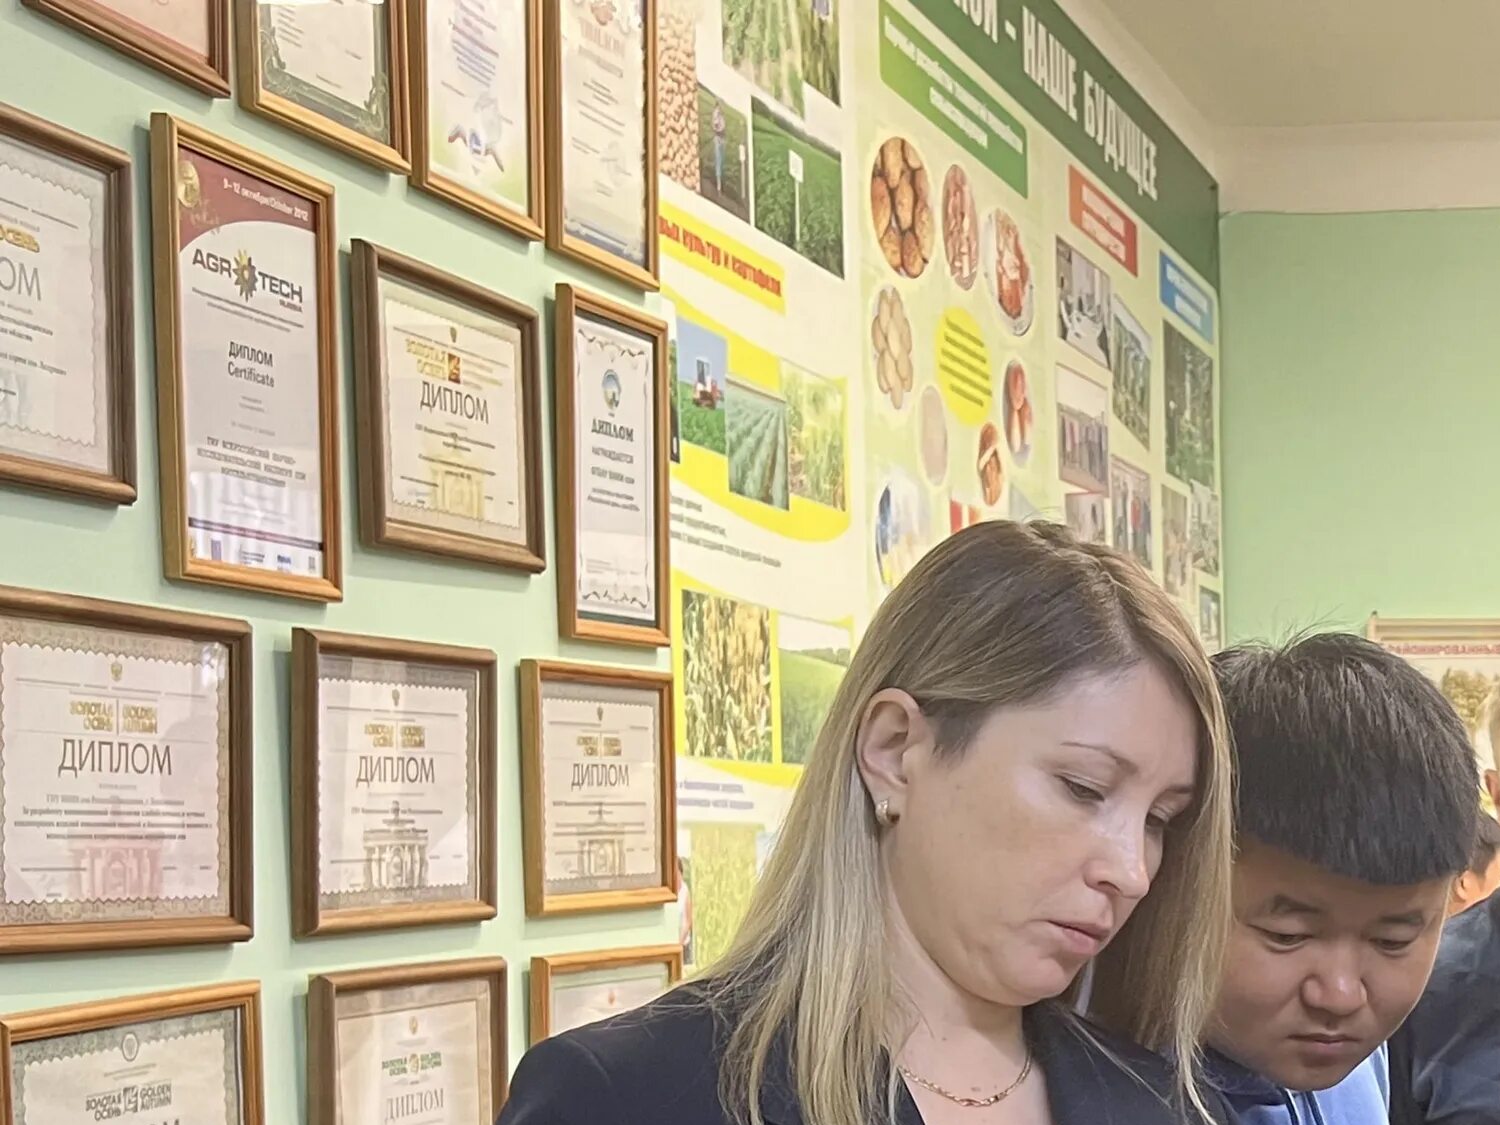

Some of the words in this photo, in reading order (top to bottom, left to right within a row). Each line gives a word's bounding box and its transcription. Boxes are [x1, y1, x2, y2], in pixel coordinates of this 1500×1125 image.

[1022, 4, 1077, 122] НАШЕ
[1083, 69, 1158, 201] БУДУЩЕЕ
[228, 341, 274, 367] ДИПЛОМ
[227, 361, 275, 388] Certificate
[420, 381, 489, 424] ДИПЛОМ
[591, 417, 634, 442] ДИПЛОМ
[58, 738, 172, 779] ДИПЛОМ
[356, 755, 435, 788] ДИПЛОМ
[571, 763, 629, 792] ДИПЛОМ
